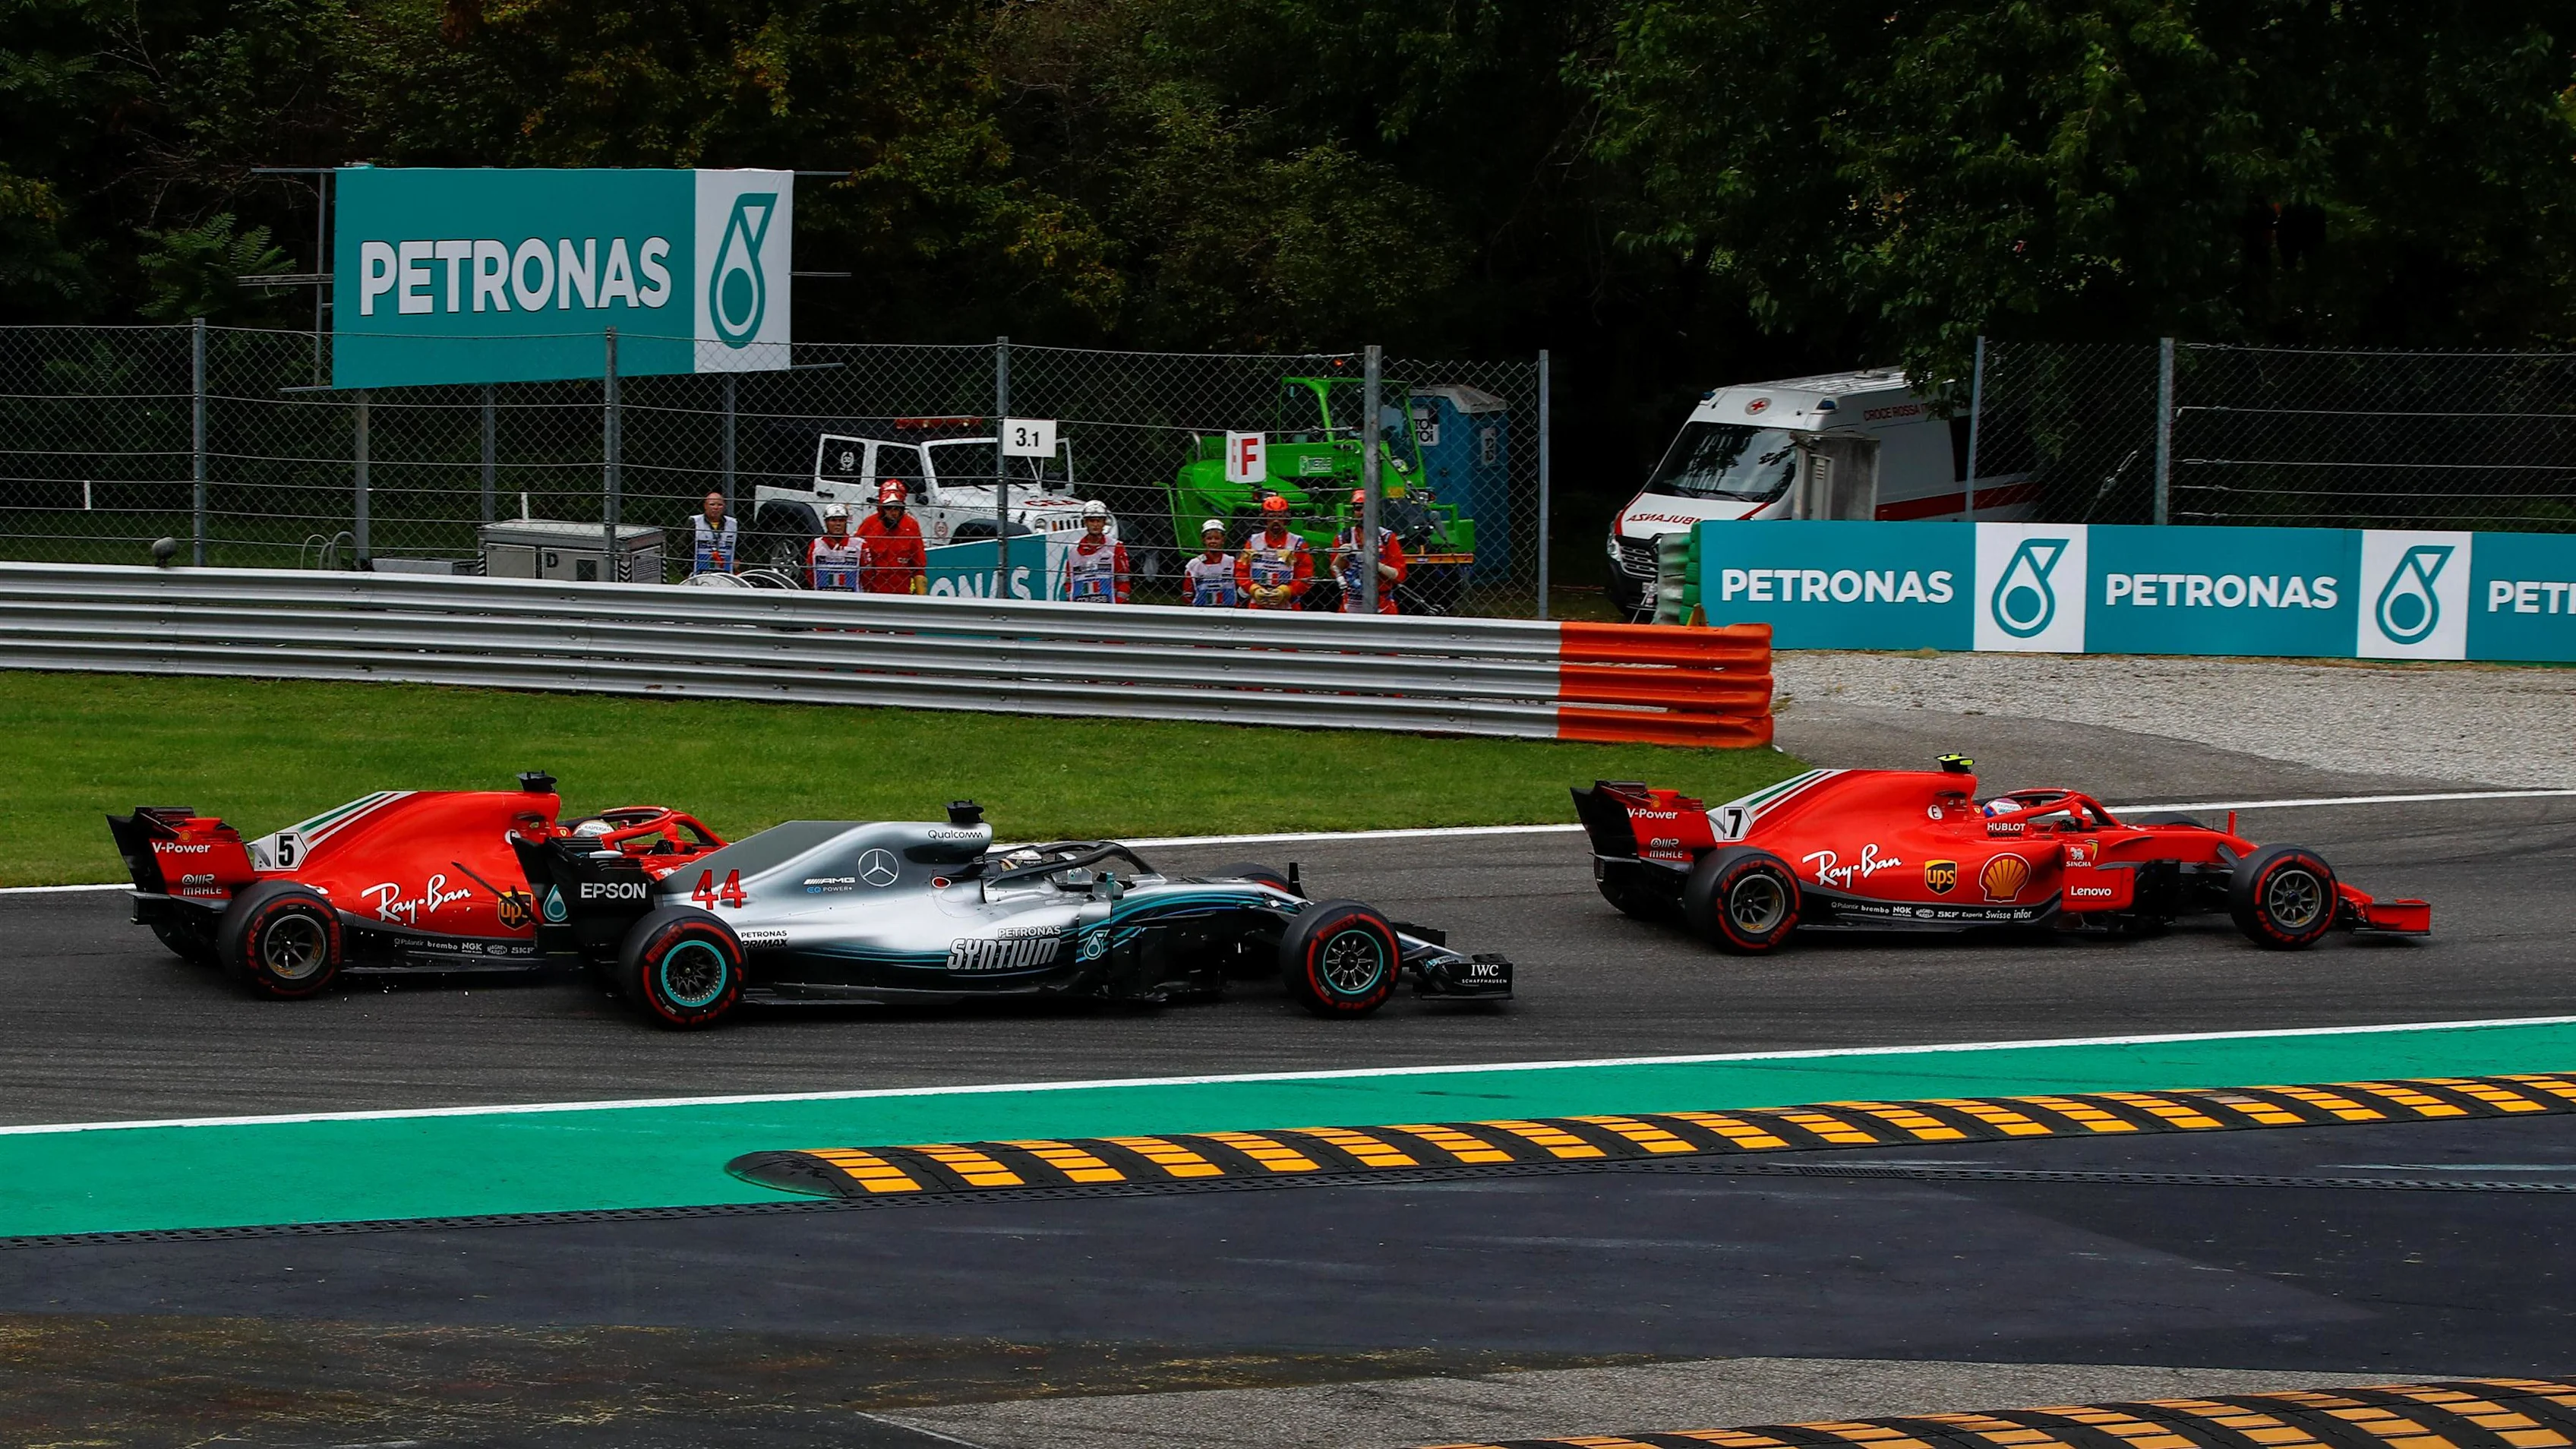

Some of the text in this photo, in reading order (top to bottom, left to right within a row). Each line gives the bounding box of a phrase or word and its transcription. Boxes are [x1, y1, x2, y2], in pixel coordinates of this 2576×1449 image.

[359, 236, 671, 317] PETRONAS
[1864, 408, 1892, 421] CROCE
[1893, 404, 1920, 417] ROSSA
[1015, 428, 1039, 447] 3.1
[1242, 438, 1258, 475] F
[547, 553, 558, 567] D
[1721, 569, 1954, 603] PETRONAS
[2105, 573, 2338, 609] PETRONAS
[1627, 807, 1678, 819] V-Power
[1931, 807, 1938, 818] E
[1728, 810, 1742, 838] 7
[1987, 822, 2025, 832] HUBLOT
[928, 830, 983, 839] Qualcomm
[152, 841, 211, 854] V-Power
[278, 835, 295, 866] 5
[1649, 851, 1683, 859] MAHLE
[1801, 843, 1902, 888] Ray-Ban
[1927, 869, 1955, 889] ups
[183, 887, 222, 895] MAHLE
[580, 882, 646, 899] EPSON
[691, 869, 747, 910] 44
[2070, 886, 2112, 896] Lenovo
[361, 873, 472, 924] Ray-Ban
[1861, 904, 1889, 914] brembo
[1985, 910, 2011, 919] Swisse
[2013, 908, 2032, 919] infor
[998, 926, 1061, 938] PETRONAS
[427, 940, 458, 950] brembo
[462, 942, 482, 951] NGK
[742, 939, 788, 948] PRIMAX
[947, 938, 1060, 970] SYNTIUM
[1470, 964, 1498, 976] IWC
